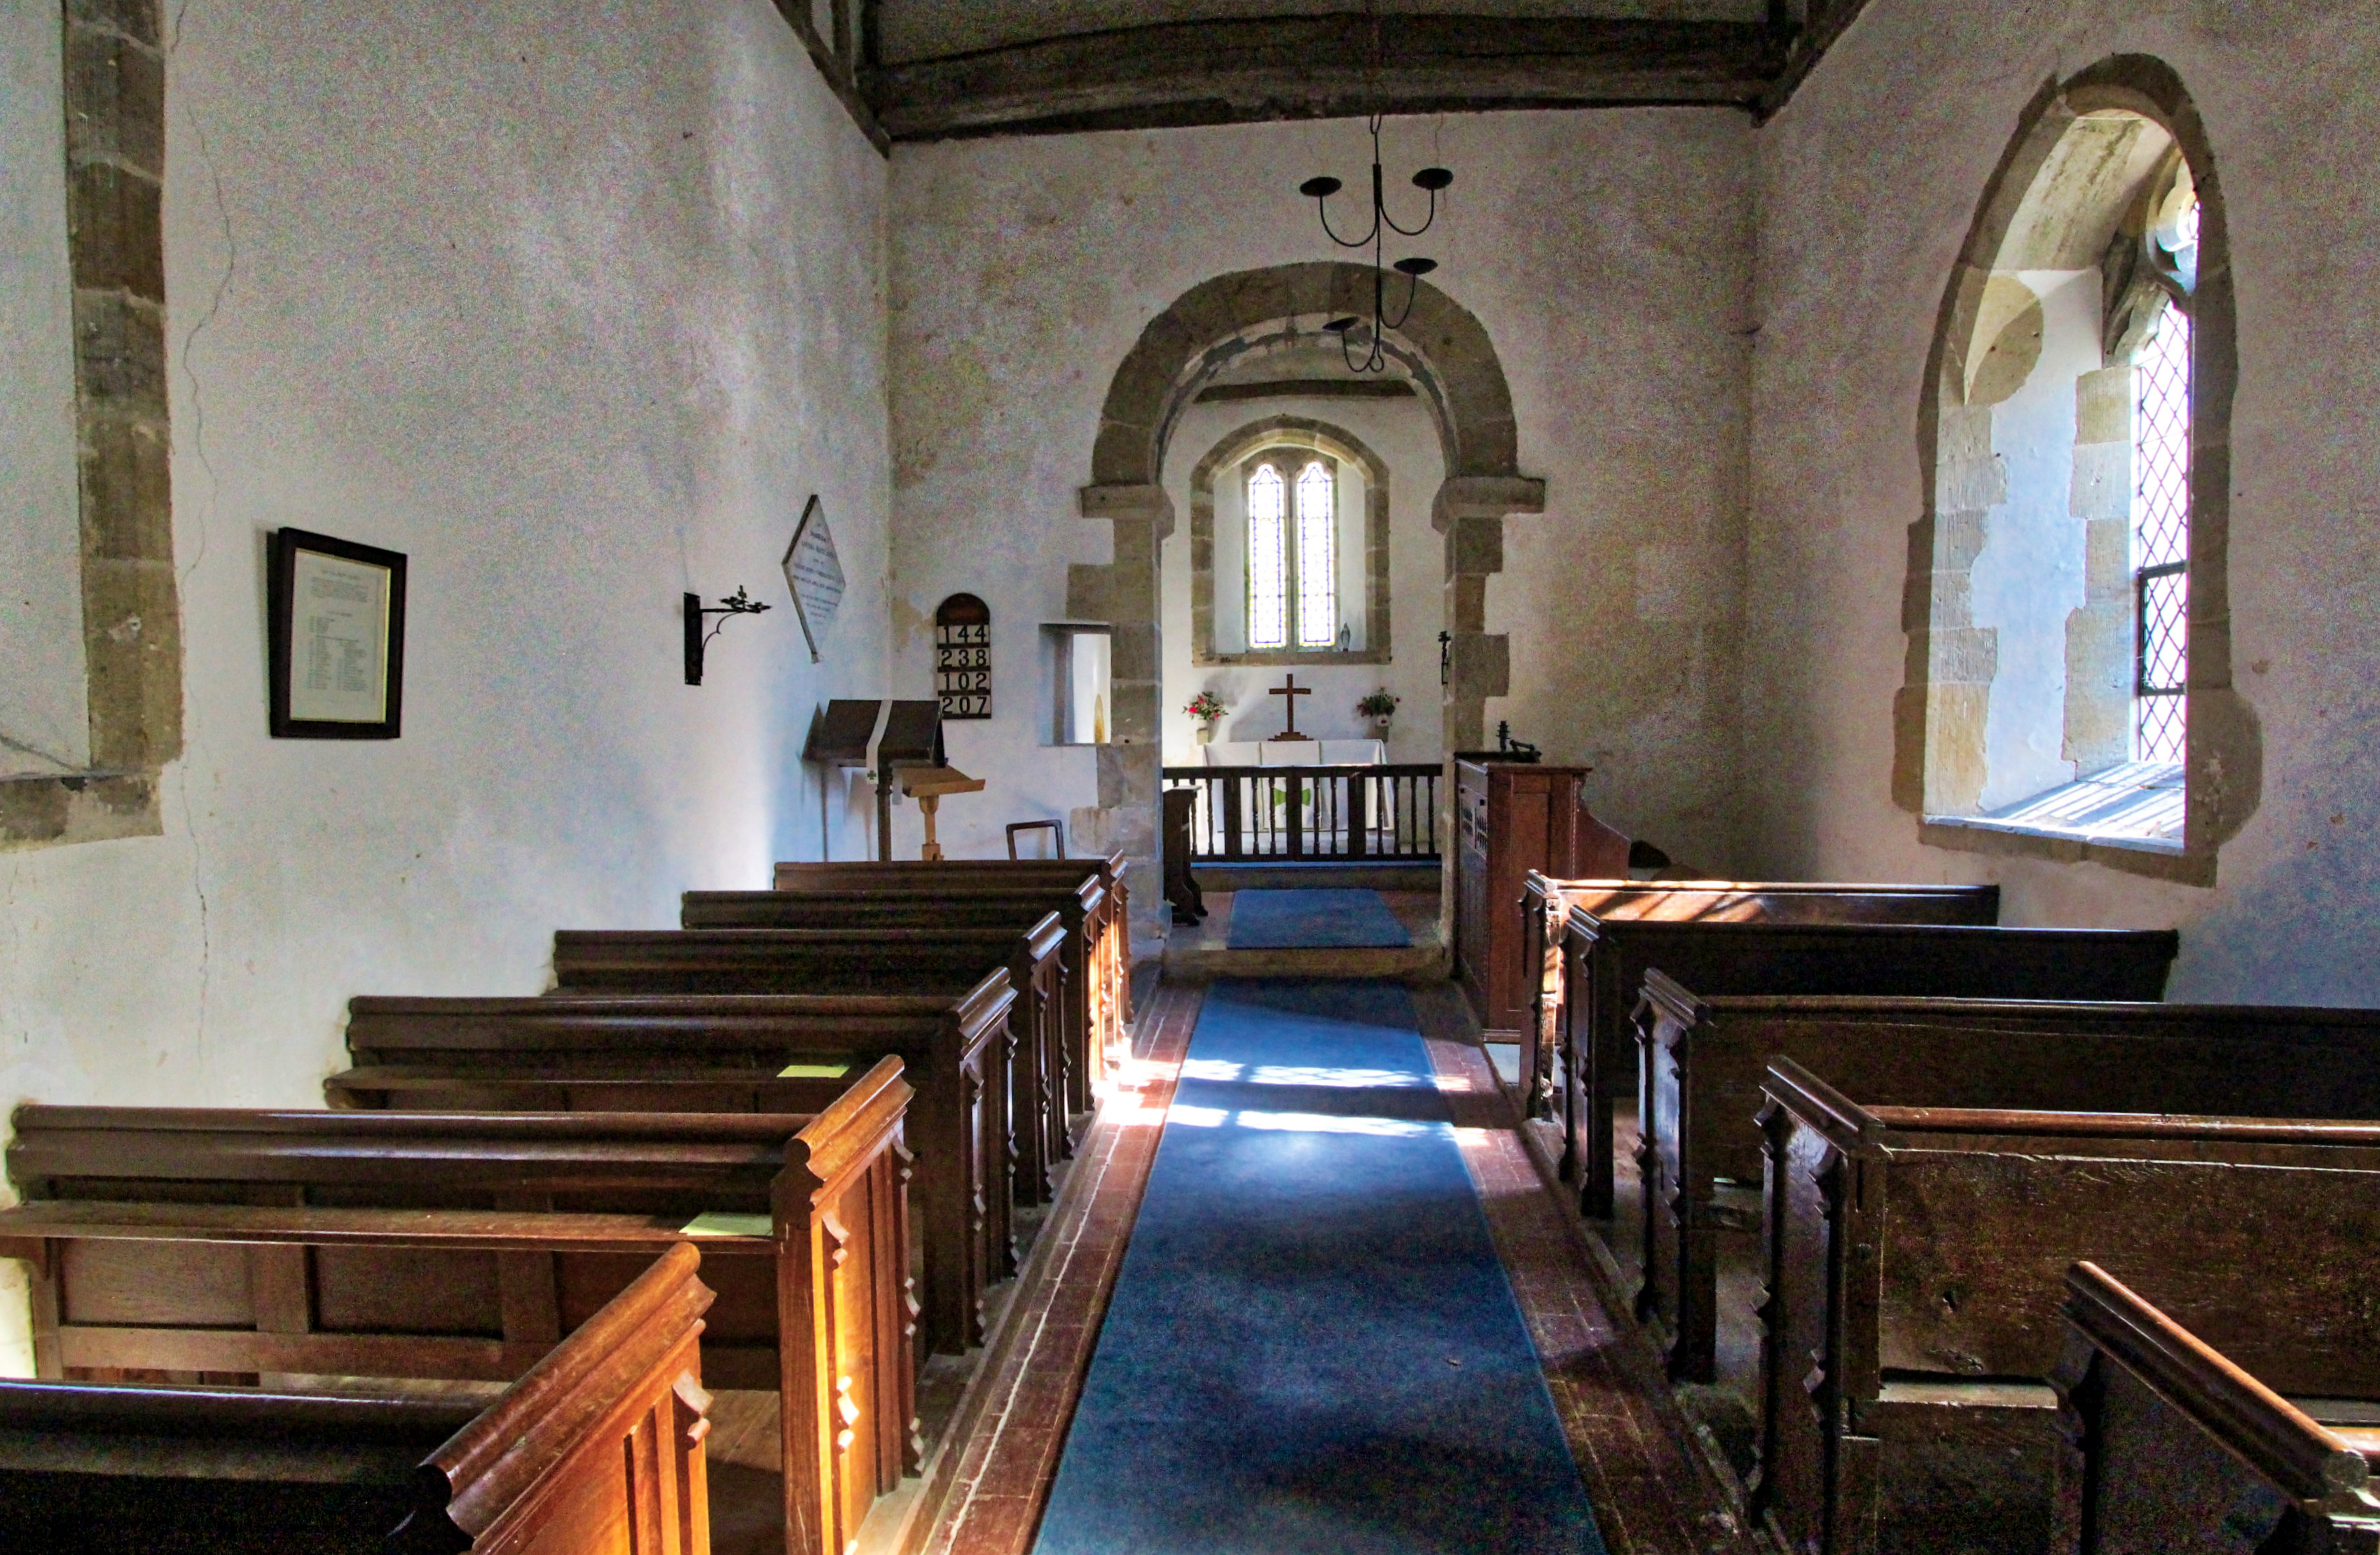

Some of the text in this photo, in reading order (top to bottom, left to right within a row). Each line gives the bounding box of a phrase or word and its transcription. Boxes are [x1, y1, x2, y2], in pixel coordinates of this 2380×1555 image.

[944, 626, 986, 643] 144
[941, 649, 986, 667] 238
[944, 672, 987, 691] 102
[942, 696, 987, 714] 207
